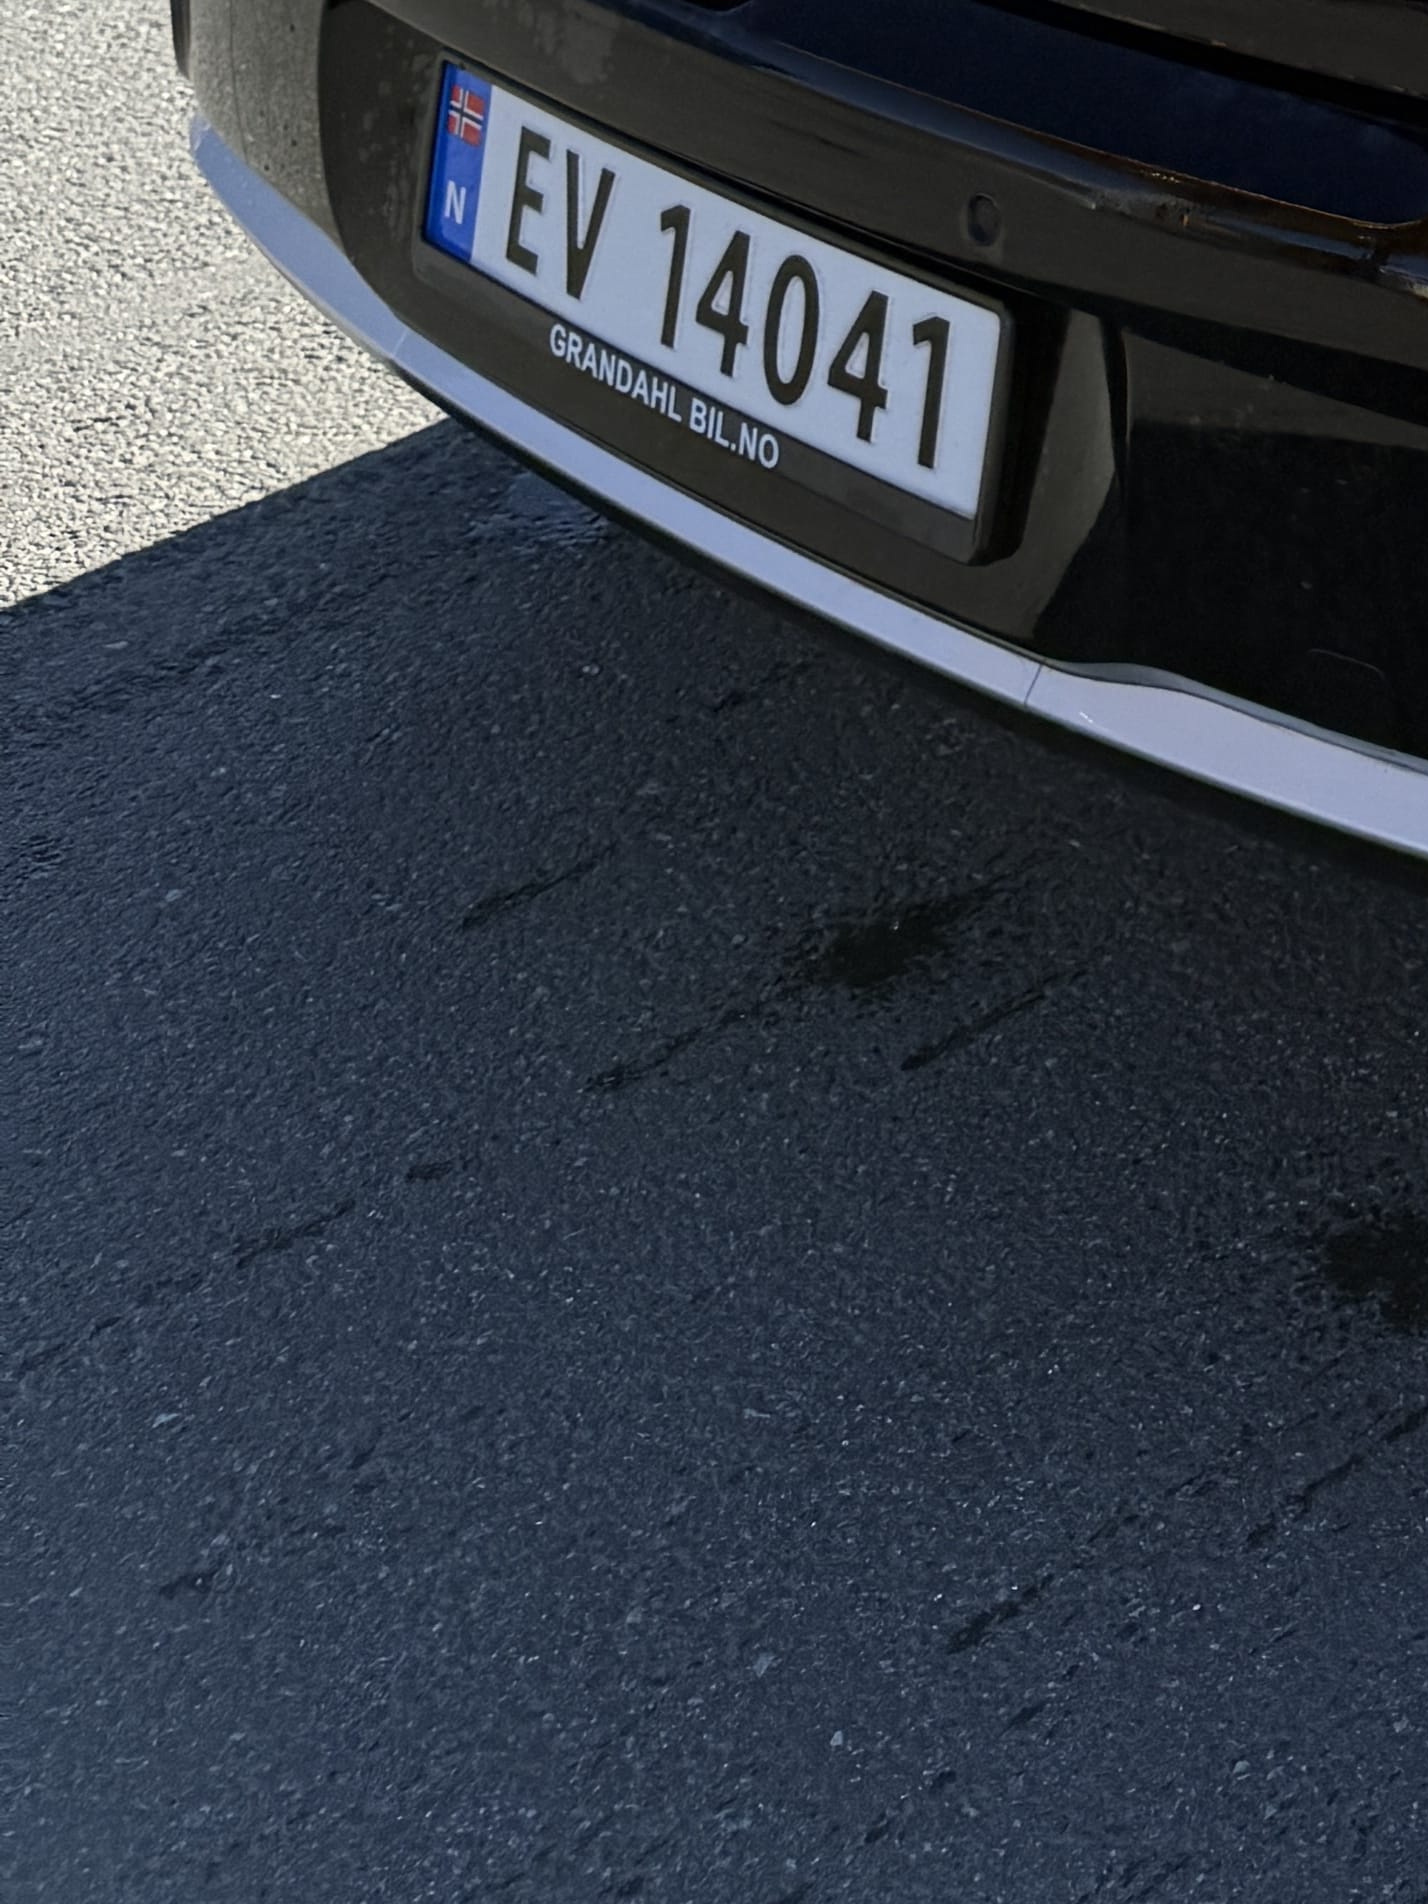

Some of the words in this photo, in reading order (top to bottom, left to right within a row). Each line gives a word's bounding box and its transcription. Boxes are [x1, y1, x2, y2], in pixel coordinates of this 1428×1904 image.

[444, 179, 467, 225] N
[505, 124, 617, 302] EV
[660, 203, 952, 470] 14041
[549, 323, 683, 423] GRANDAHL
[688, 402, 780, 470] BIL.NO
